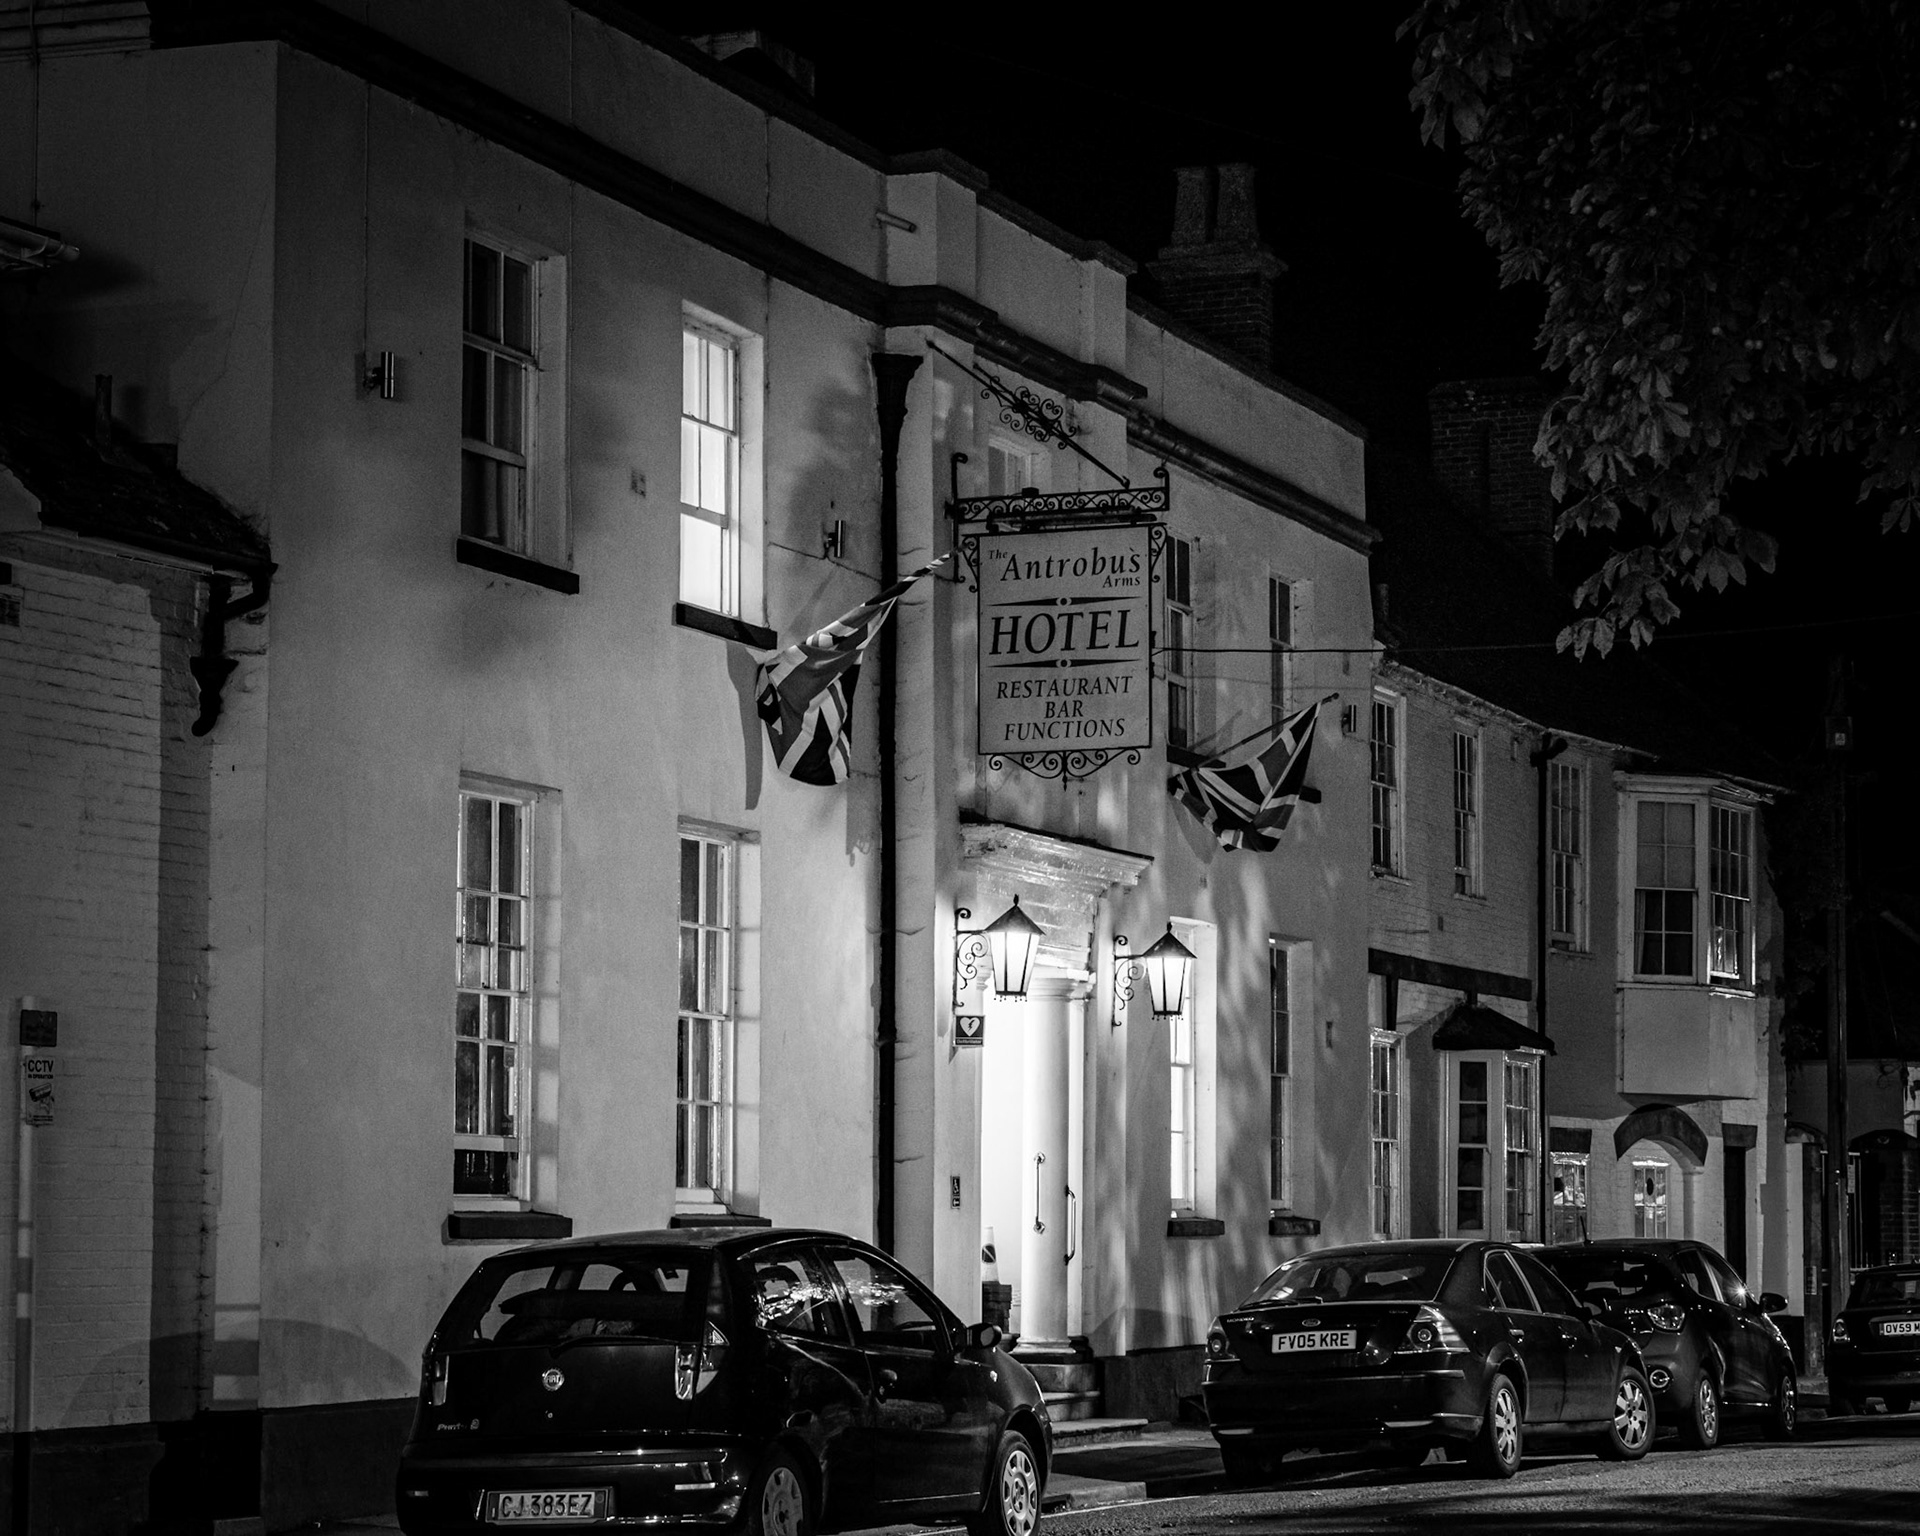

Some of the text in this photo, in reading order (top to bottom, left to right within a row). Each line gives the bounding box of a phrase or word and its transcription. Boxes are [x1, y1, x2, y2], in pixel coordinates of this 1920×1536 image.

[989, 549, 1008, 560] The
[1102, 575, 1141, 588] Arms
[989, 609, 1140, 655] HOTEL
[997, 676, 1133, 699] RESTAURANT
[1044, 700, 1084, 719] BAR
[1004, 718, 1125, 741] FUNCTIONS
[28, 1060, 54, 1072] CCTV
[1886, 1323, 1912, 1333] OV59
[1278, 1333, 1349, 1350] FV05 KRE
